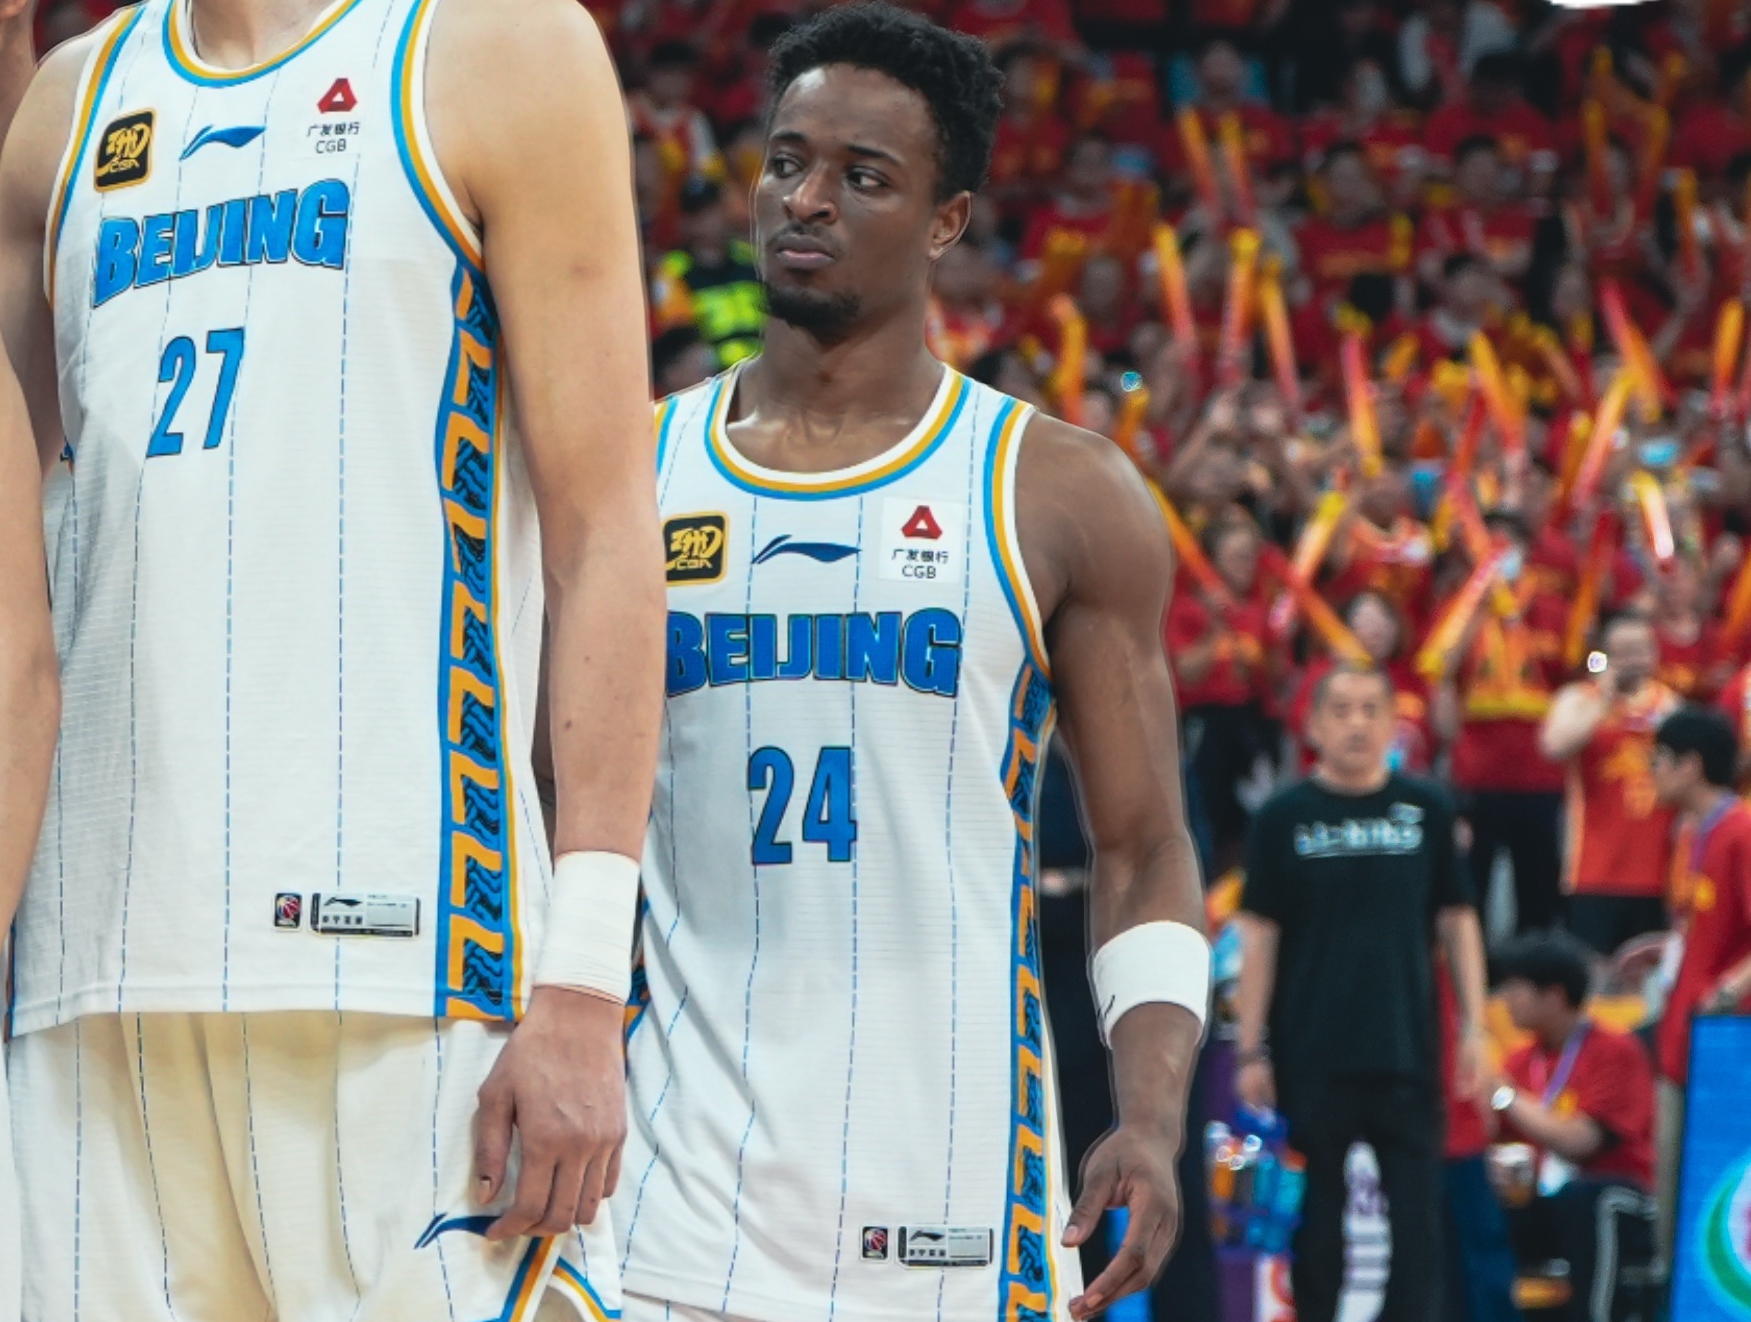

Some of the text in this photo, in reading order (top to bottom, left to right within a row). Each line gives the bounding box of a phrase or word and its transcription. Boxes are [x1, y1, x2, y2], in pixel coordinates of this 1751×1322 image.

[315, 138, 347, 154] CGB
[92, 178, 351, 309] BEIJING
[145, 327, 246, 459] 27
[901, 564, 937, 579] CGB
[666, 607, 963, 699] BEIJING
[745, 745, 858, 866] 24
